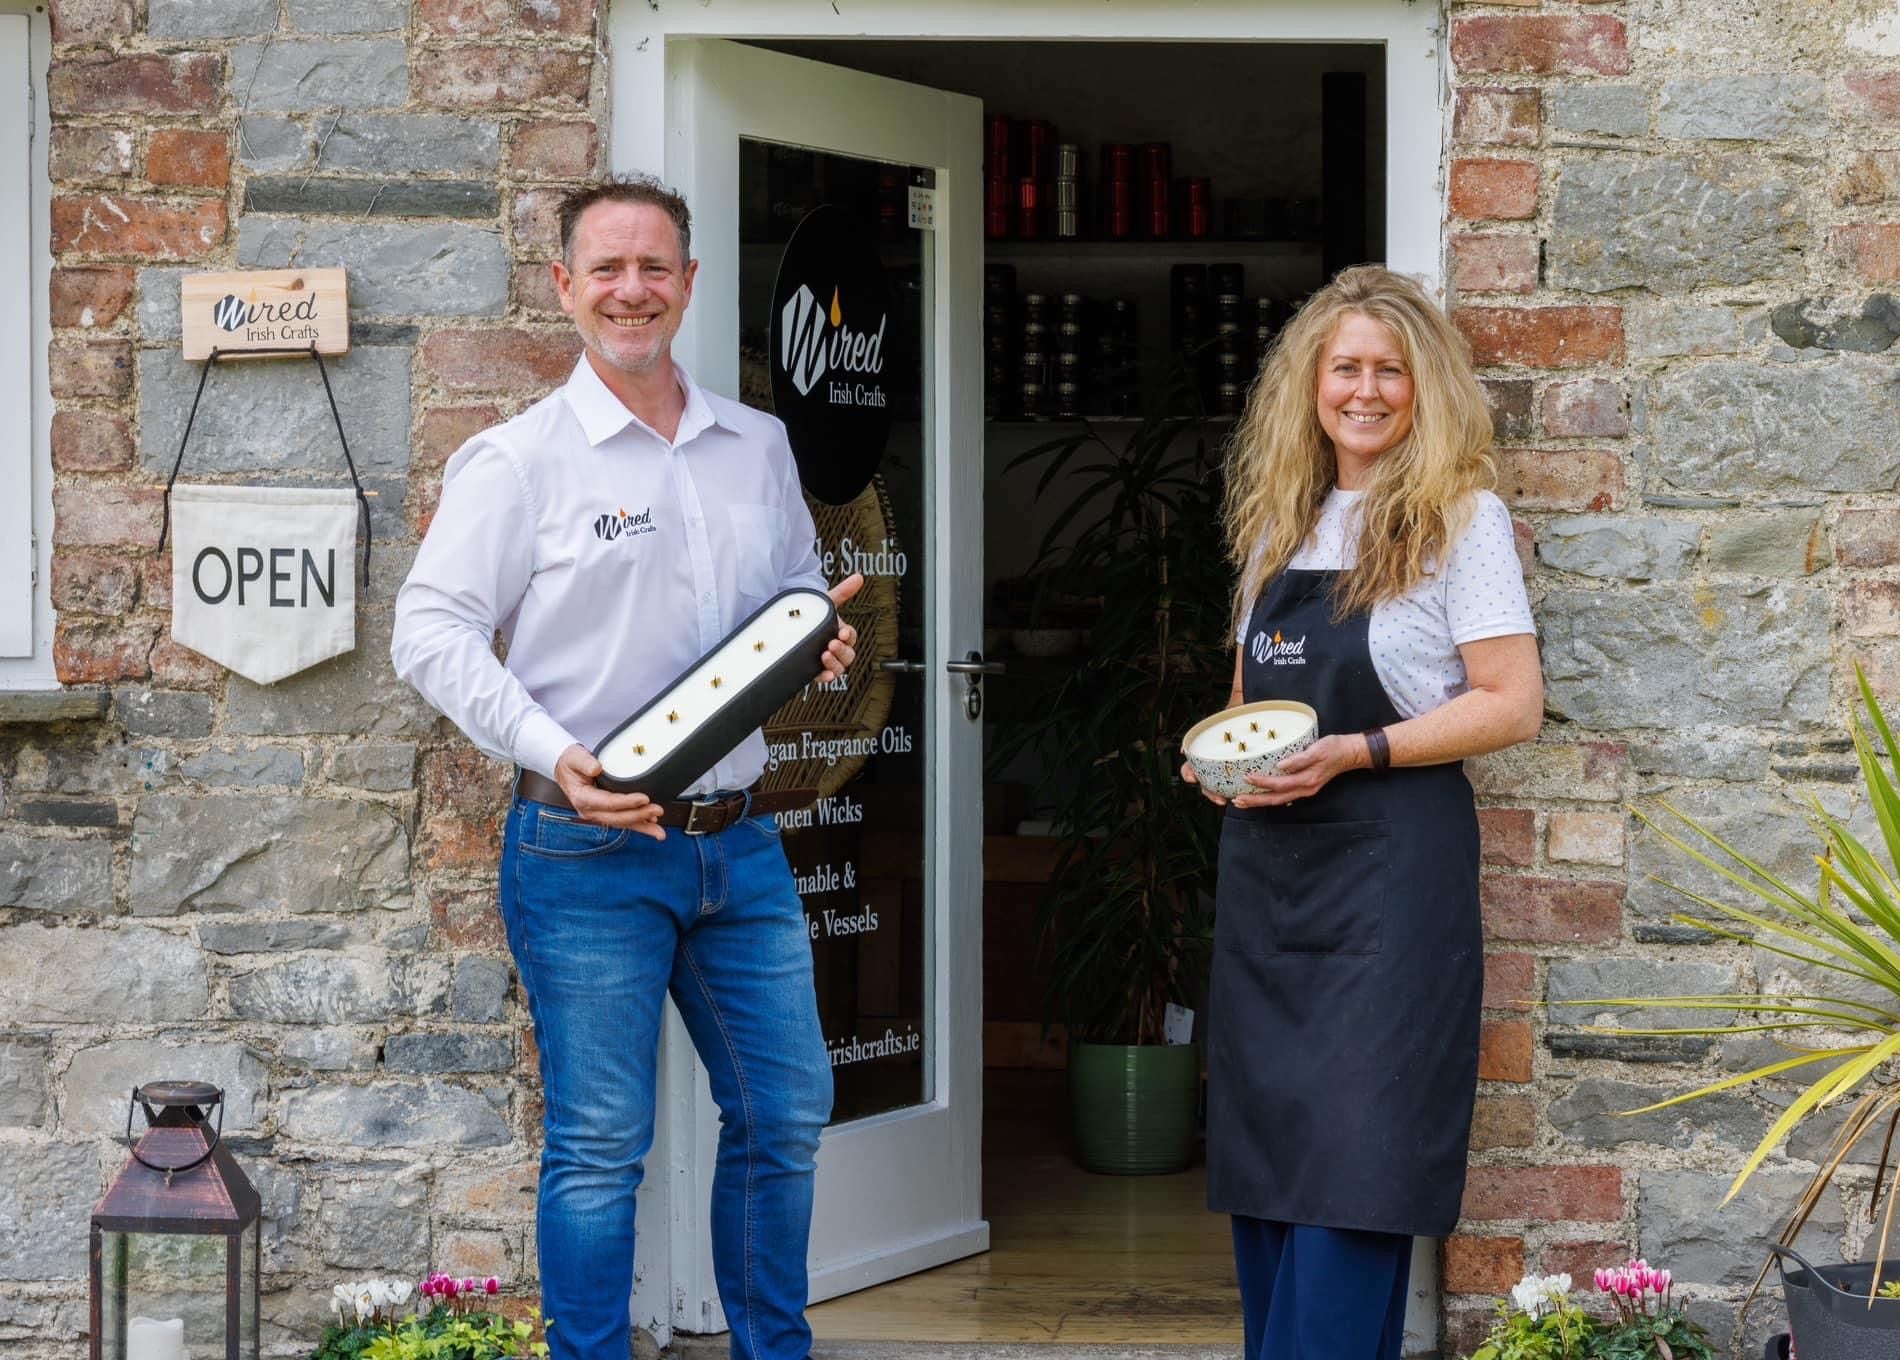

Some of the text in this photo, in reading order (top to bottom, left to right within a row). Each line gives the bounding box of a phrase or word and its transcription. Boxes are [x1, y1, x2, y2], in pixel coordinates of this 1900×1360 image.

[214, 290, 318, 332] Wired
[247, 324, 319, 341] Irish Crafts
[782, 284, 886, 396] Wired
[829, 381, 886, 407] Irish Crafts
[594, 507, 652, 541] Wired
[841, 537, 907, 576] Studio
[192, 546, 336, 608] OPEN
[1252, 629, 1306, 664] Wired
[1274, 657, 1287, 665] Irish
[801, 731, 878, 766] Fragrance
[881, 726, 912, 754] Oils
[816, 796, 863, 825] Wicks
[843, 861, 856, 889] &
[822, 904, 878, 937] Vessels
[825, 1025, 920, 1067] irishcrafts.ie
